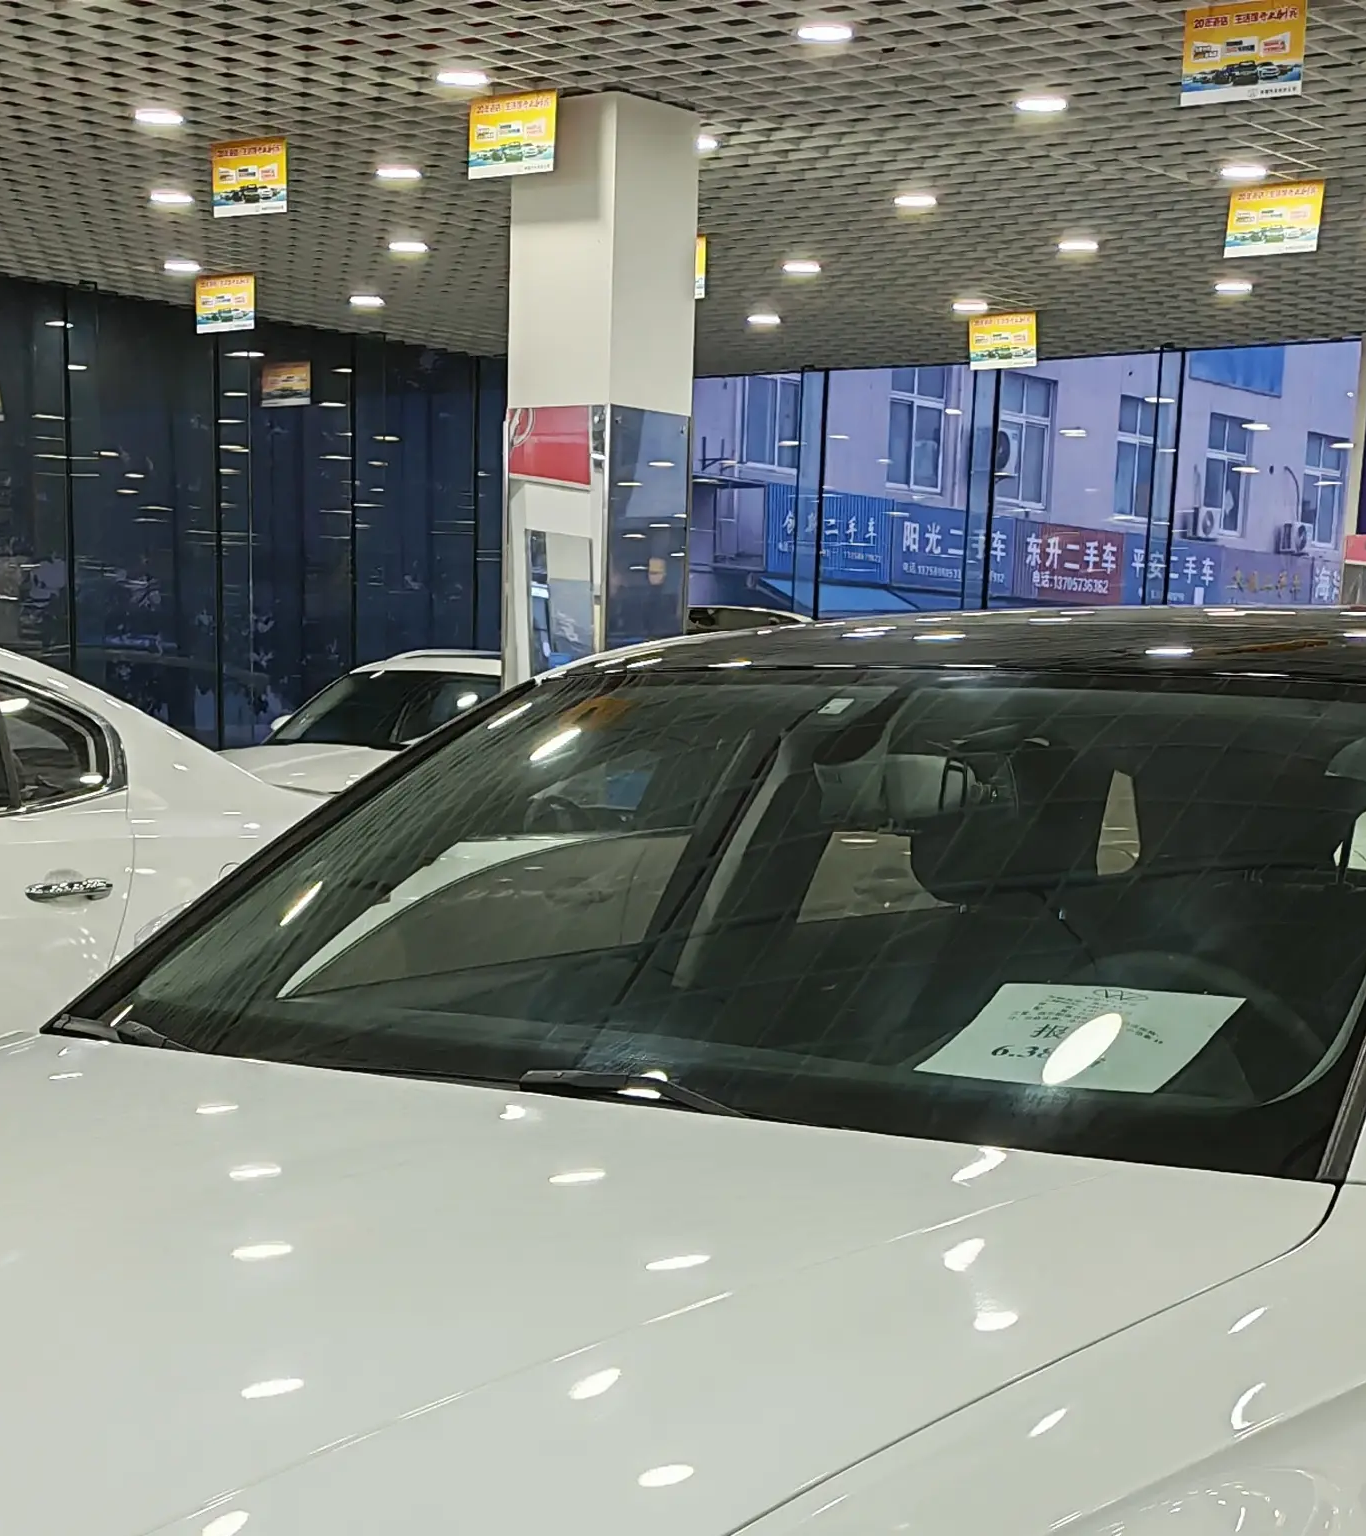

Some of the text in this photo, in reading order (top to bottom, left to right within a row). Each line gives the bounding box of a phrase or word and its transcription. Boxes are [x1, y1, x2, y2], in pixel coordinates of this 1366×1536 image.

[902, 521, 1008, 562] 阳光二手车
[1026, 532, 1118, 574] 东升二手车
[1131, 548, 1215, 586] 平安二手车
